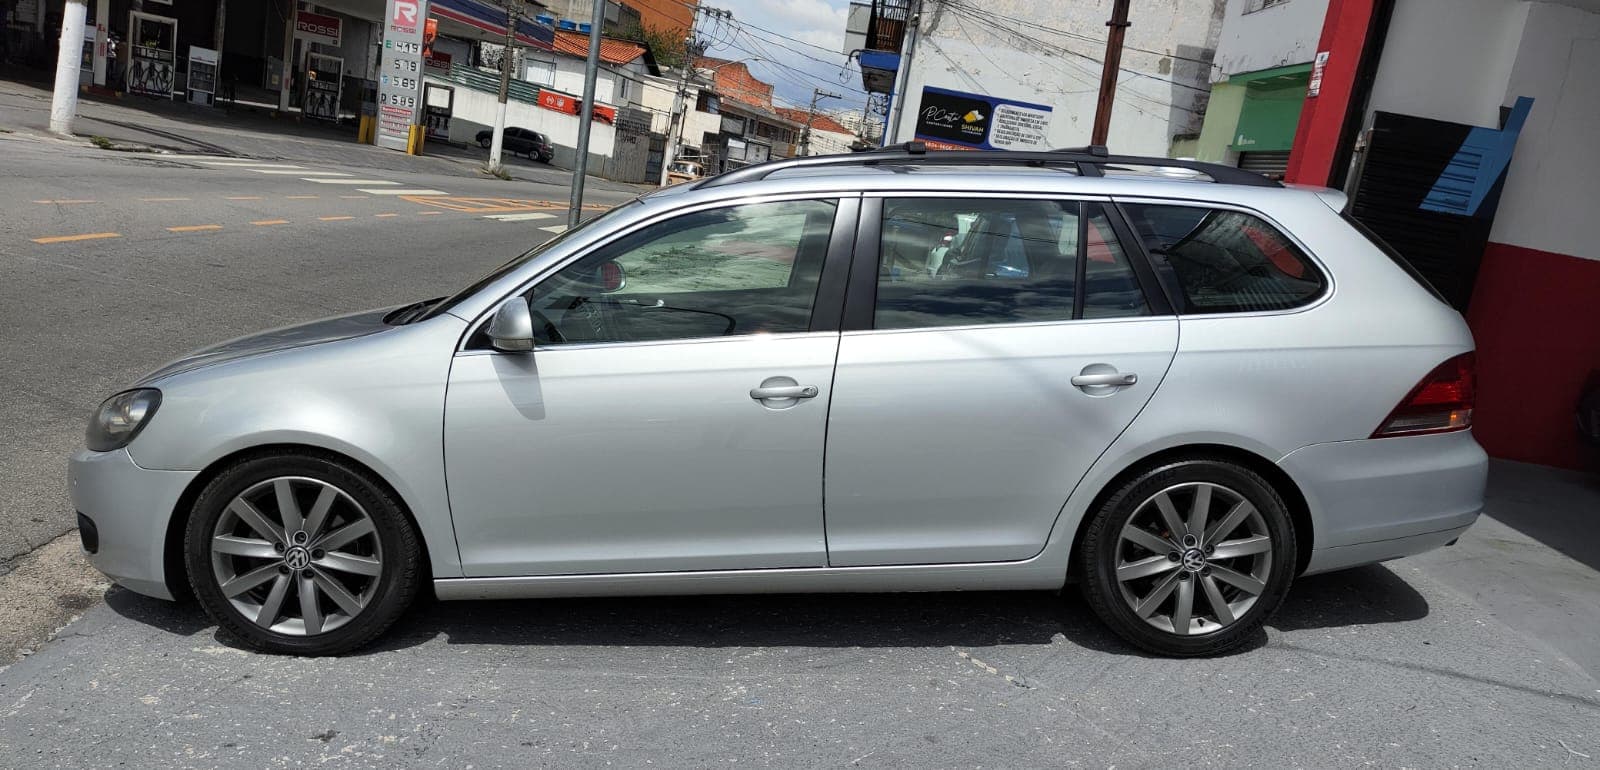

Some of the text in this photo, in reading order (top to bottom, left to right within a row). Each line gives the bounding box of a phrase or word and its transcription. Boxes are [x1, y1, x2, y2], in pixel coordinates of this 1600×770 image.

[297, 20, 339, 37] ROSSI
[391, 25, 417, 34] ROSSI
[385, 40, 392, 48] E
[425, 58, 450, 70] OSSI
